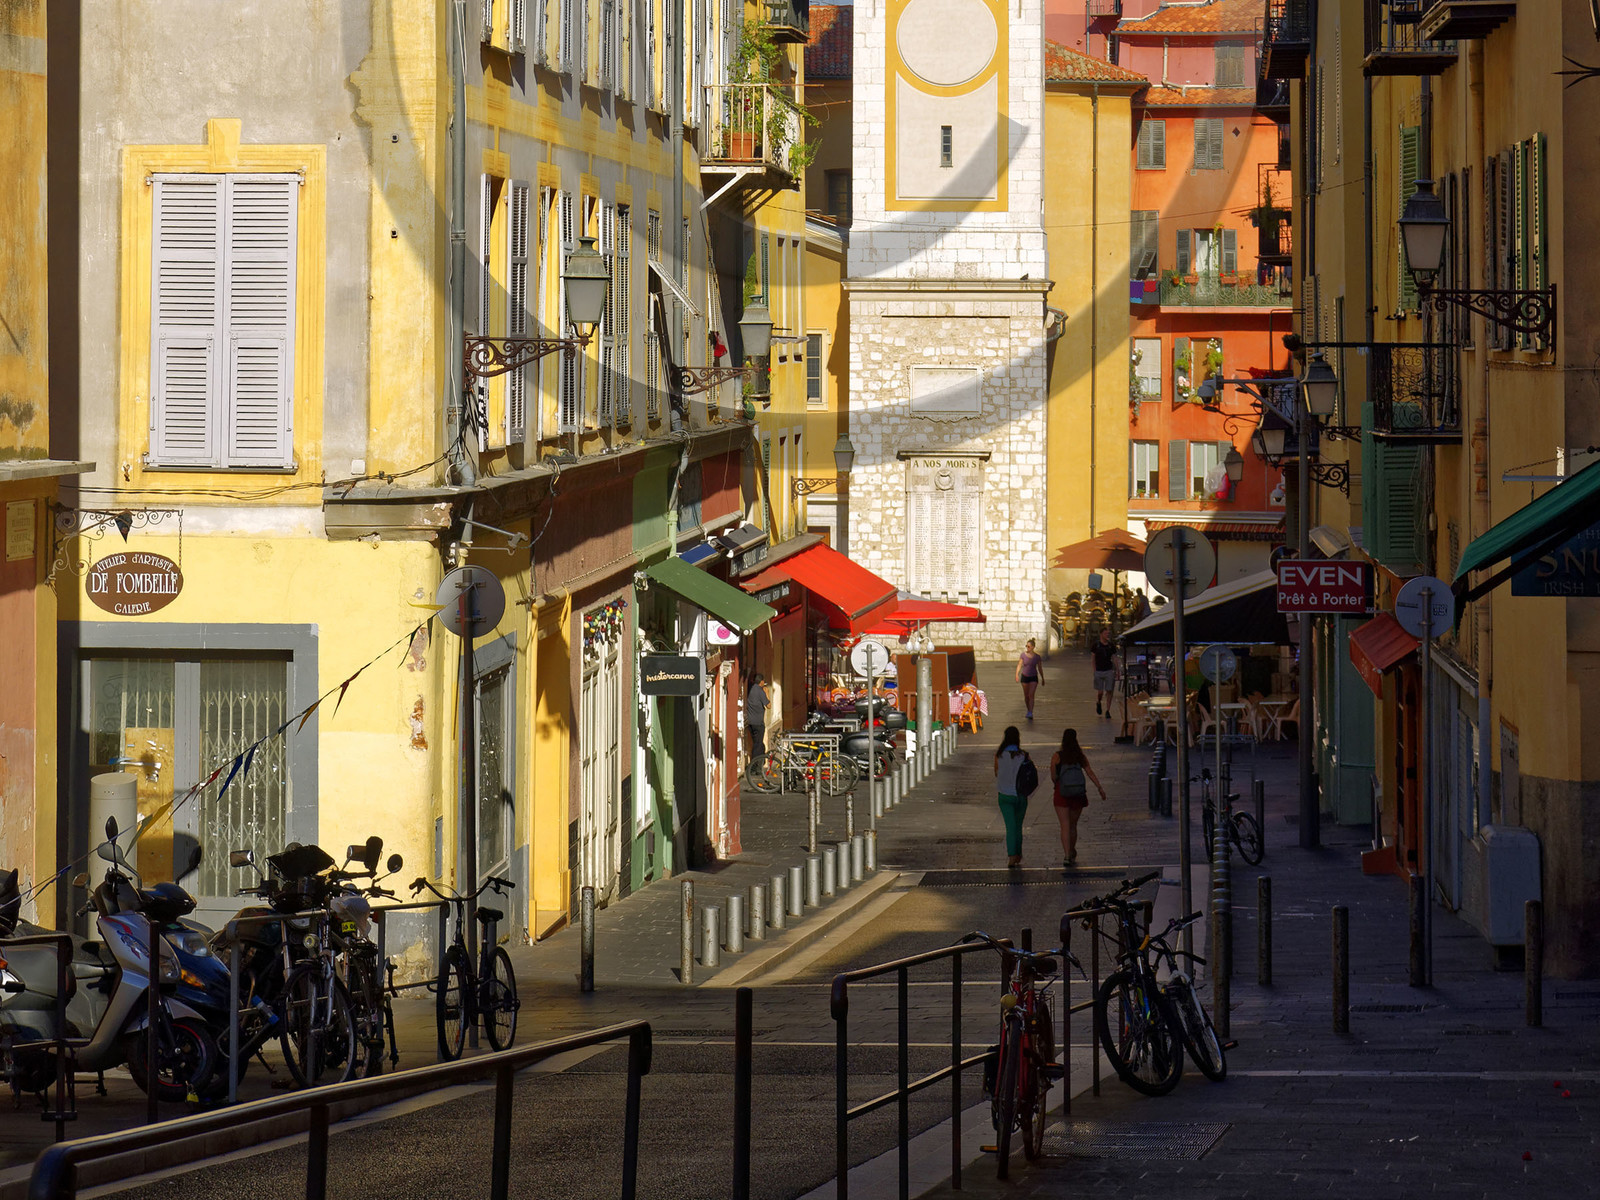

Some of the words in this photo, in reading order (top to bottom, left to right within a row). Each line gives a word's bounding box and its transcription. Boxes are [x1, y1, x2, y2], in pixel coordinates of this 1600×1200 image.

[913, 460, 919, 468] A
[923, 460, 941, 468] NOS
[96, 554, 127, 572] ATELIER
[91, 572, 108, 593] DE
[116, 572, 178, 594] FOMBELLE
[1280, 566, 1362, 587] EVEN
[1544, 581, 1584, 594] IRISH
[1279, 592, 1304, 605] Prêt
[1309, 593, 1318, 605] à
[1323, 592, 1363, 605] Porter
[114, 602, 151, 614] GALERIE
